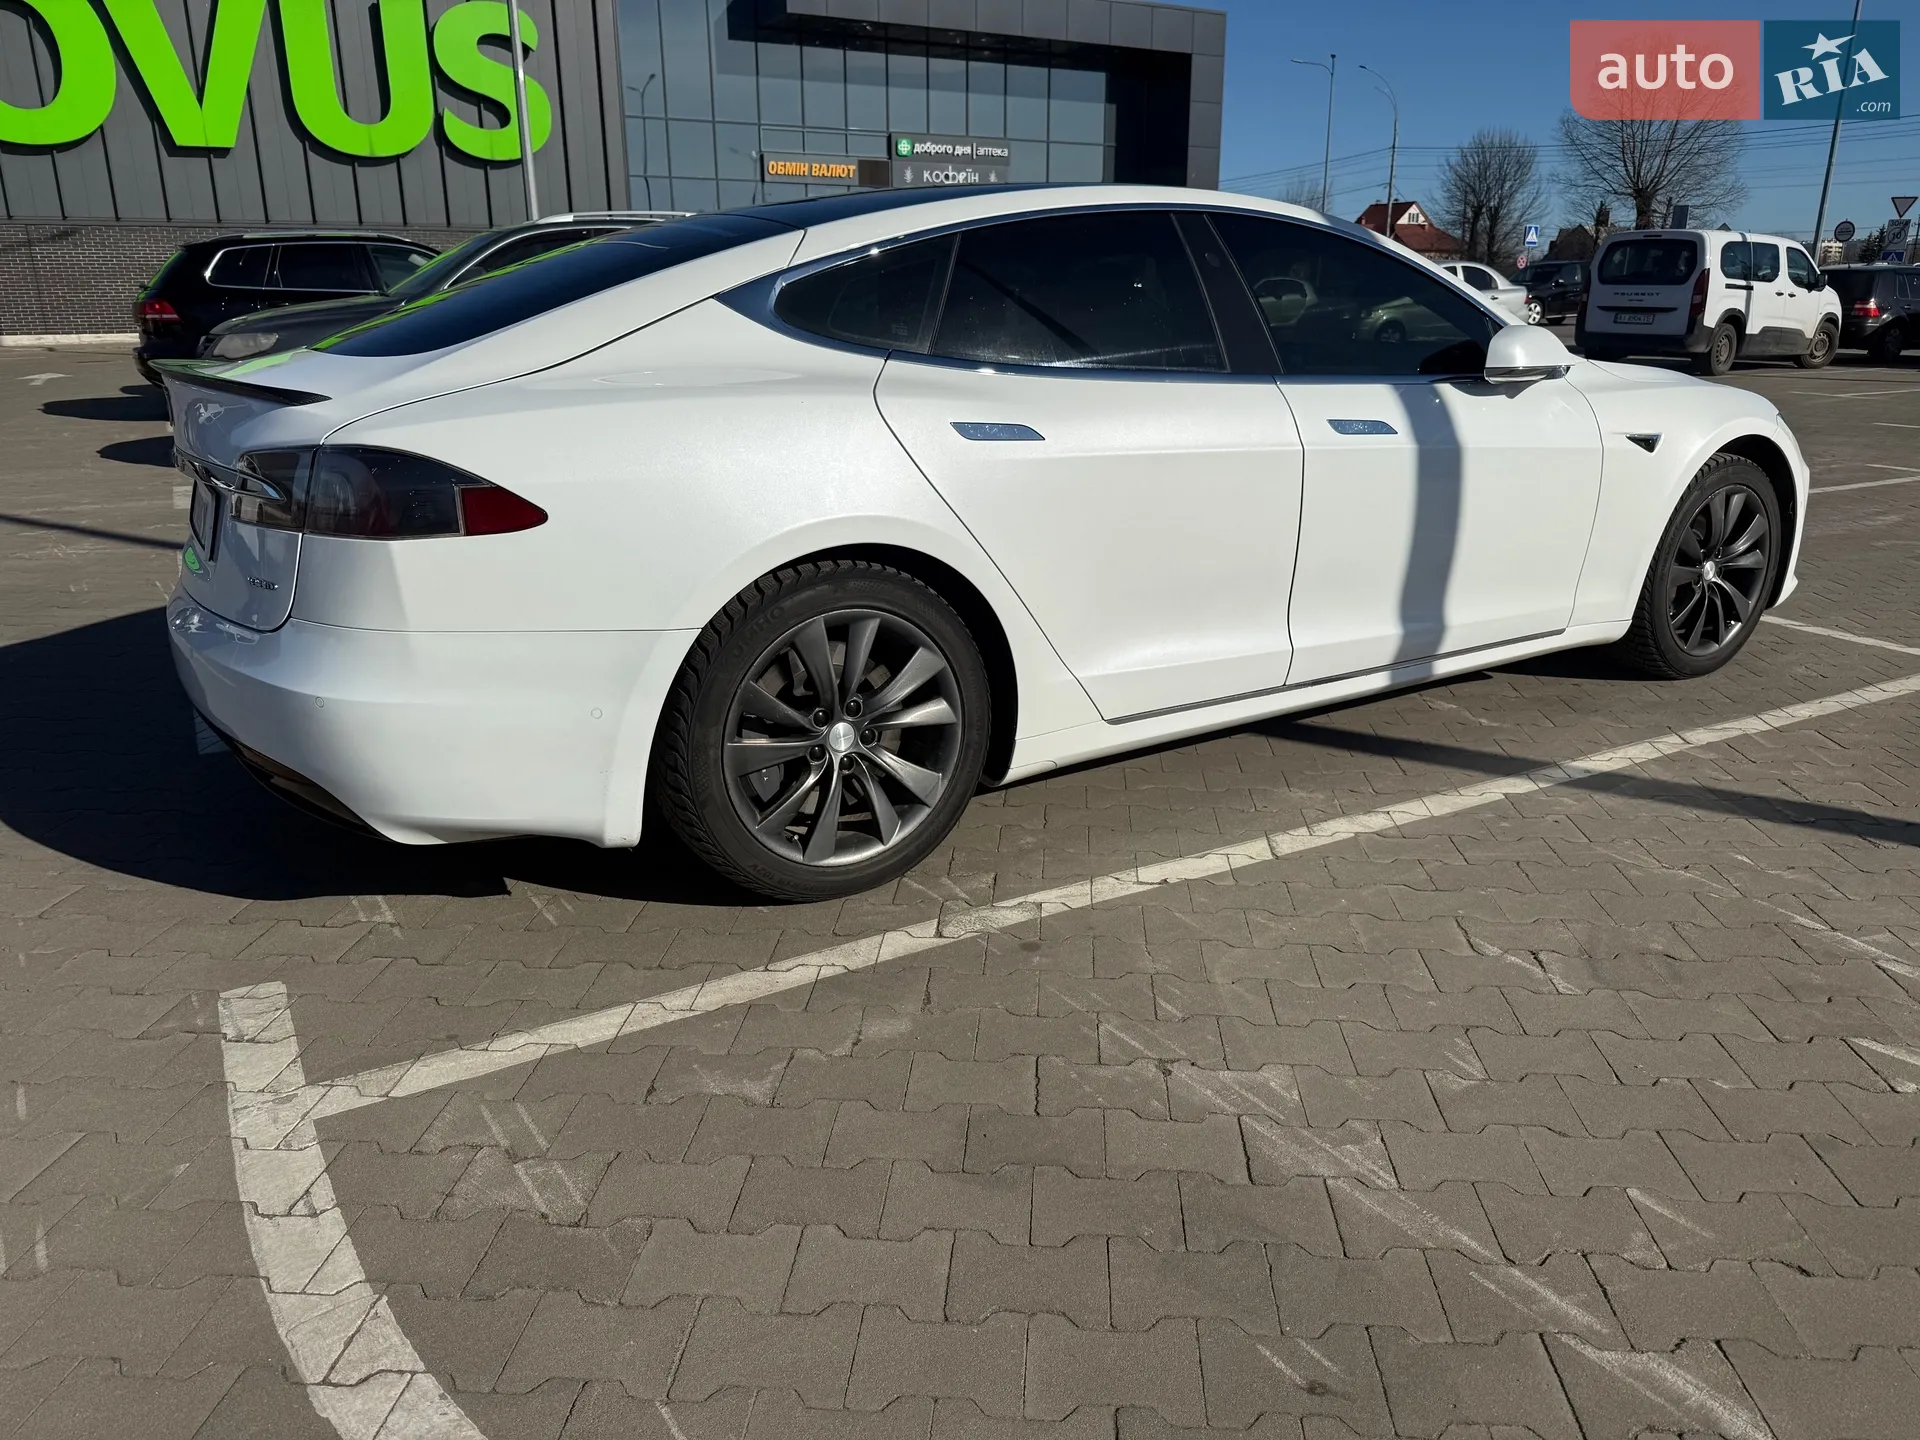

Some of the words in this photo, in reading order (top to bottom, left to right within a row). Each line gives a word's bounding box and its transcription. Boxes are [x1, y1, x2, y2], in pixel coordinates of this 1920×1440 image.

[913, 142, 953, 155] доброго
[954, 145, 972, 156] дня
[977, 147, 1009, 157] аптека
[768, 160, 809, 176] ОБМІН
[811, 162, 856, 179] ВАЛЮТ
